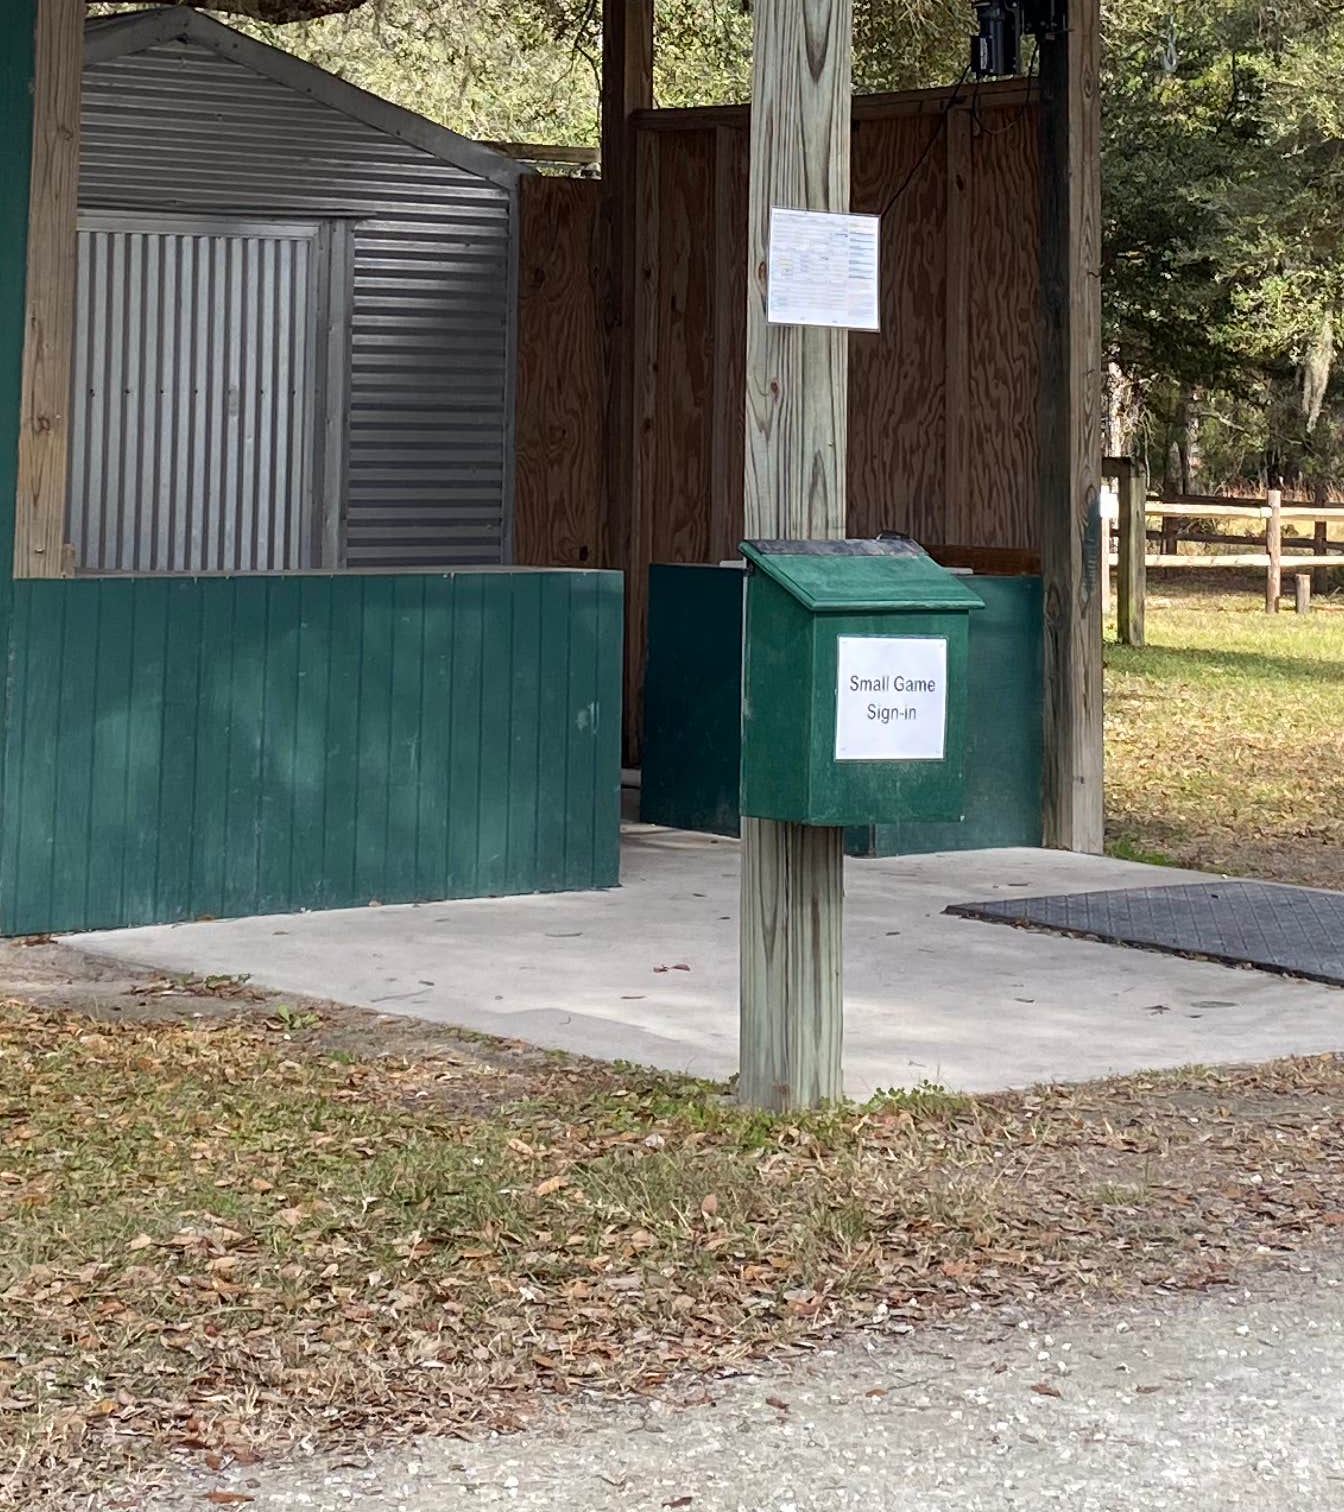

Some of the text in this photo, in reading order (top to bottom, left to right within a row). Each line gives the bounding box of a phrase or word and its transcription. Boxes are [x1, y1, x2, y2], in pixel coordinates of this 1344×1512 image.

[849, 675, 936, 692] Small Game
[866, 703, 917, 724] Sign-in
